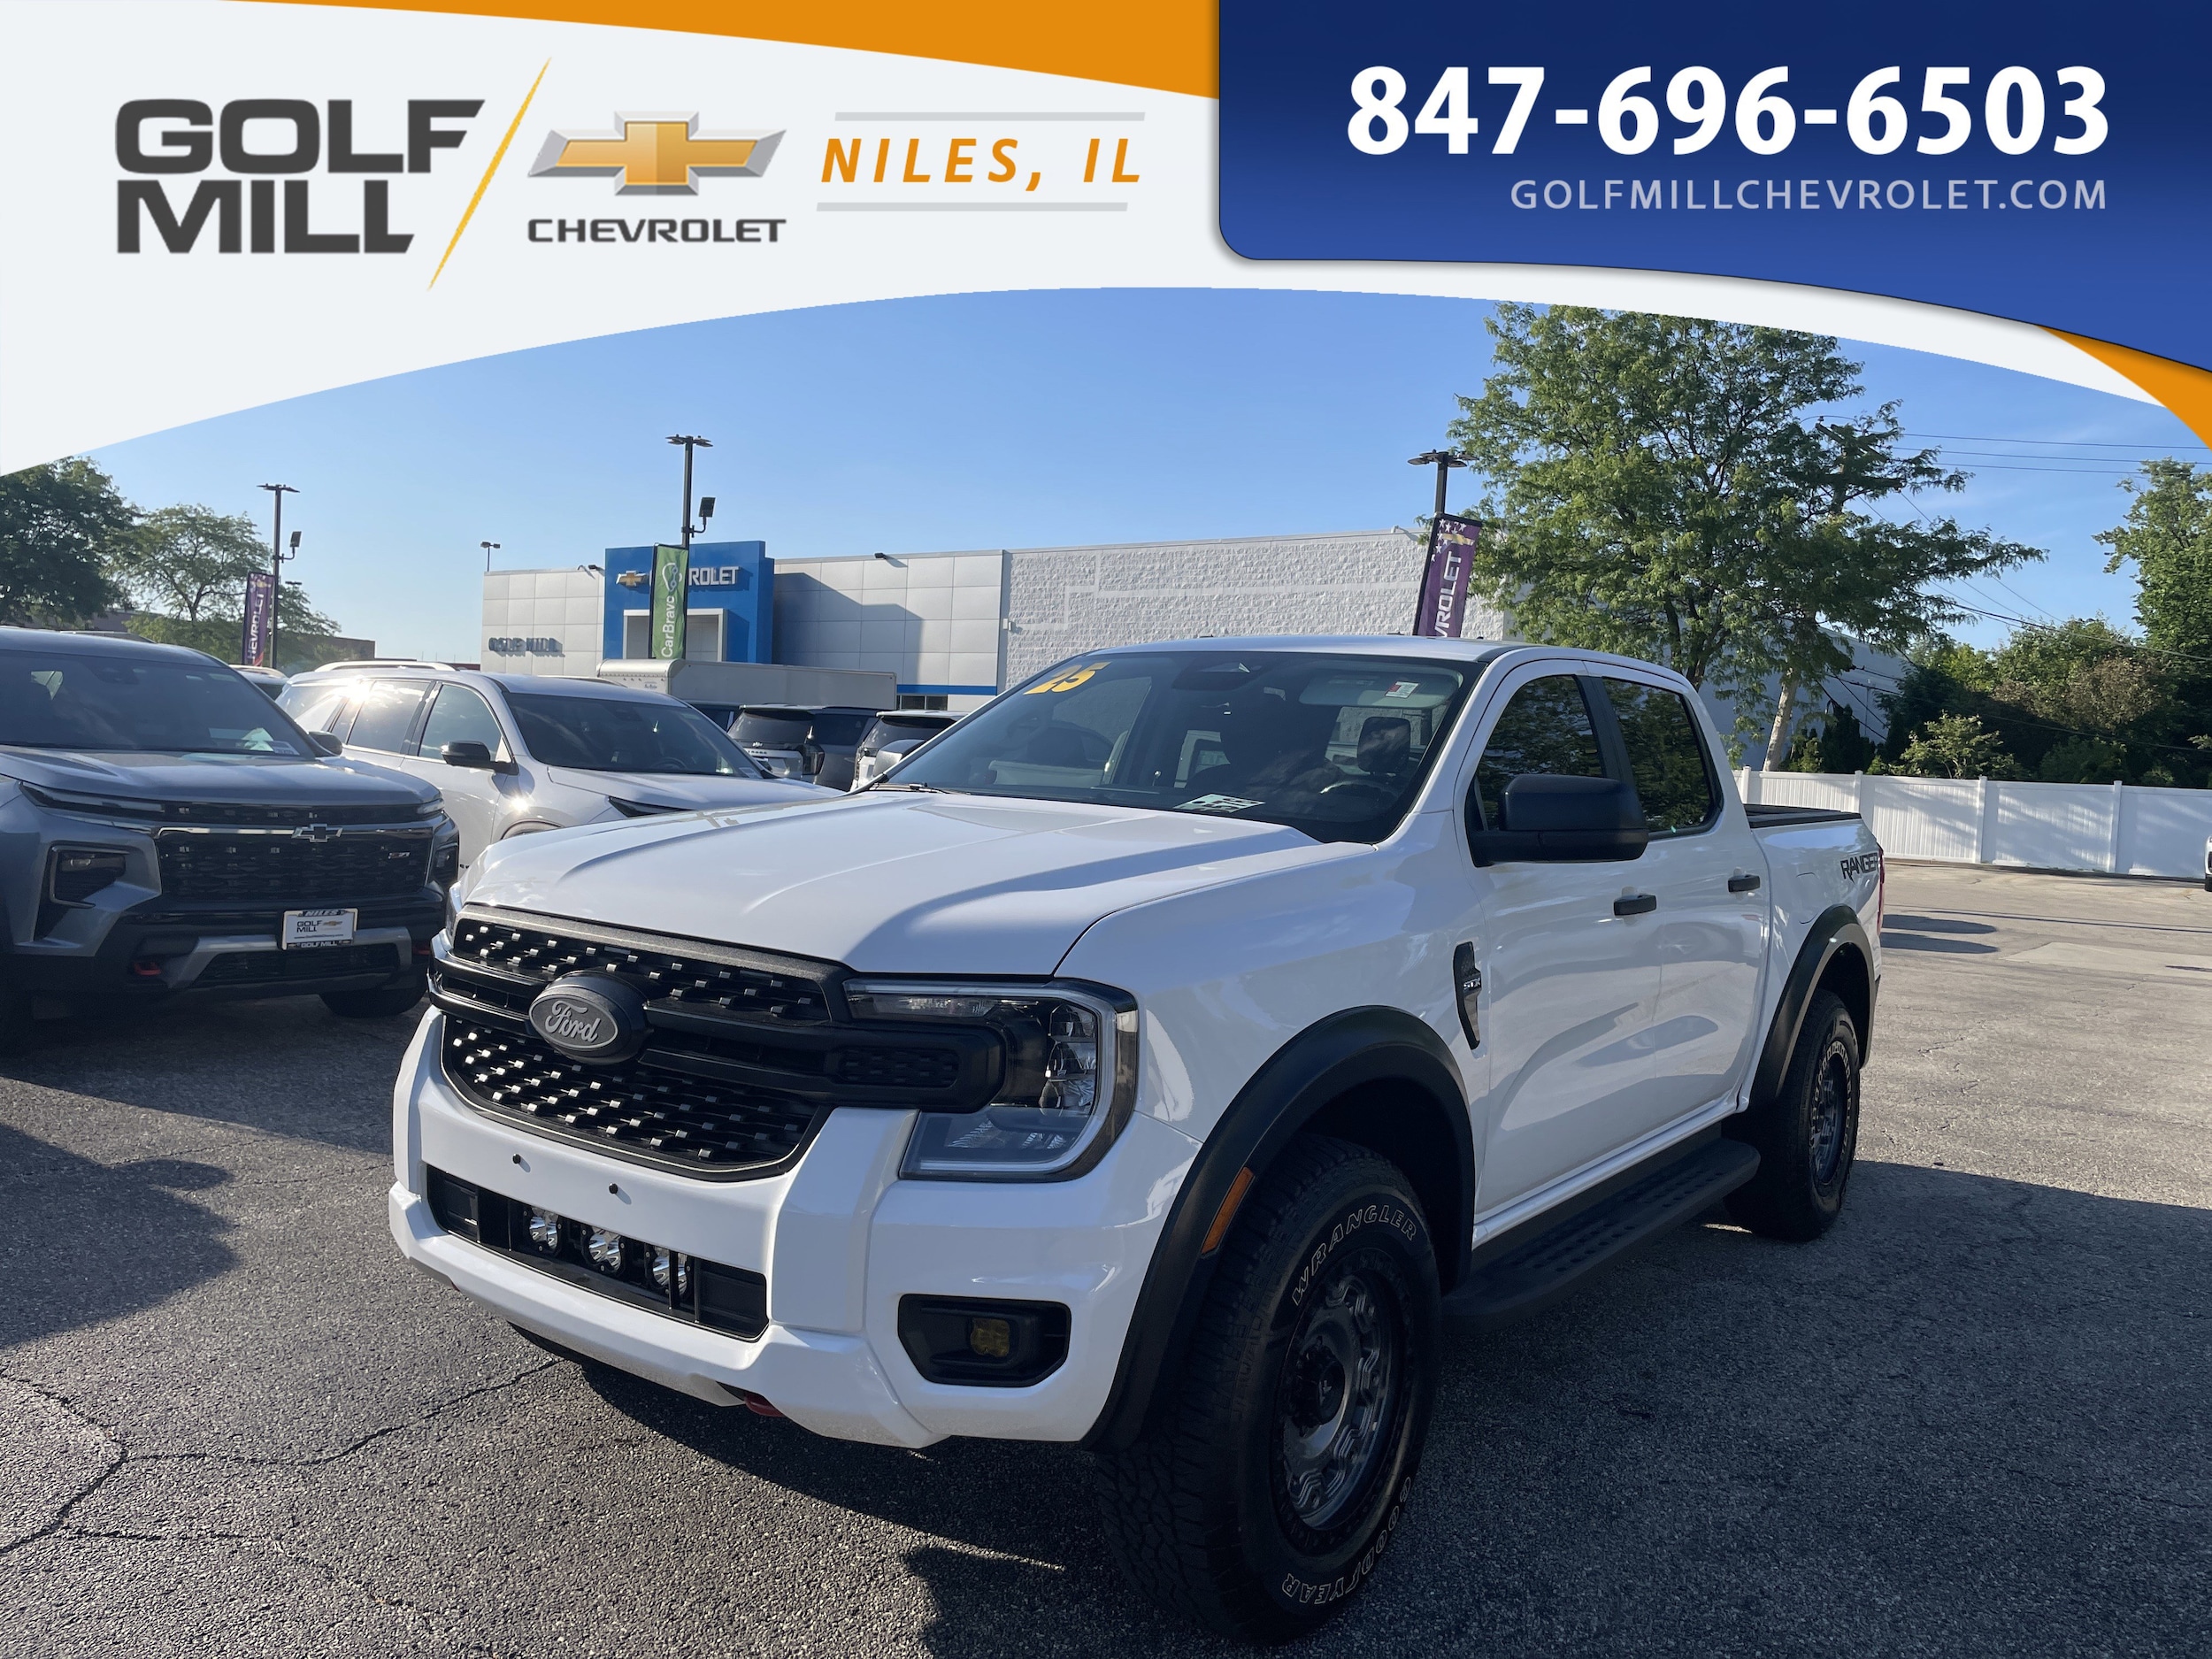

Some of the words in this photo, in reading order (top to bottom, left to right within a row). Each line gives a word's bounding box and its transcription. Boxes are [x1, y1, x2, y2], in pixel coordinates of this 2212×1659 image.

[649, 566, 740, 586] ROLET
[1434, 550, 1462, 637] VROLET
[248, 594, 265, 665] HEVROLET
[661, 595, 675, 657] CarBrave
[1840, 852, 1879, 884] RANGER
[545, 1000, 601, 1042] Ford
[1292, 1204, 1417, 1306] WRANGLER
[1282, 1476, 1412, 1605] GOODYEAR
